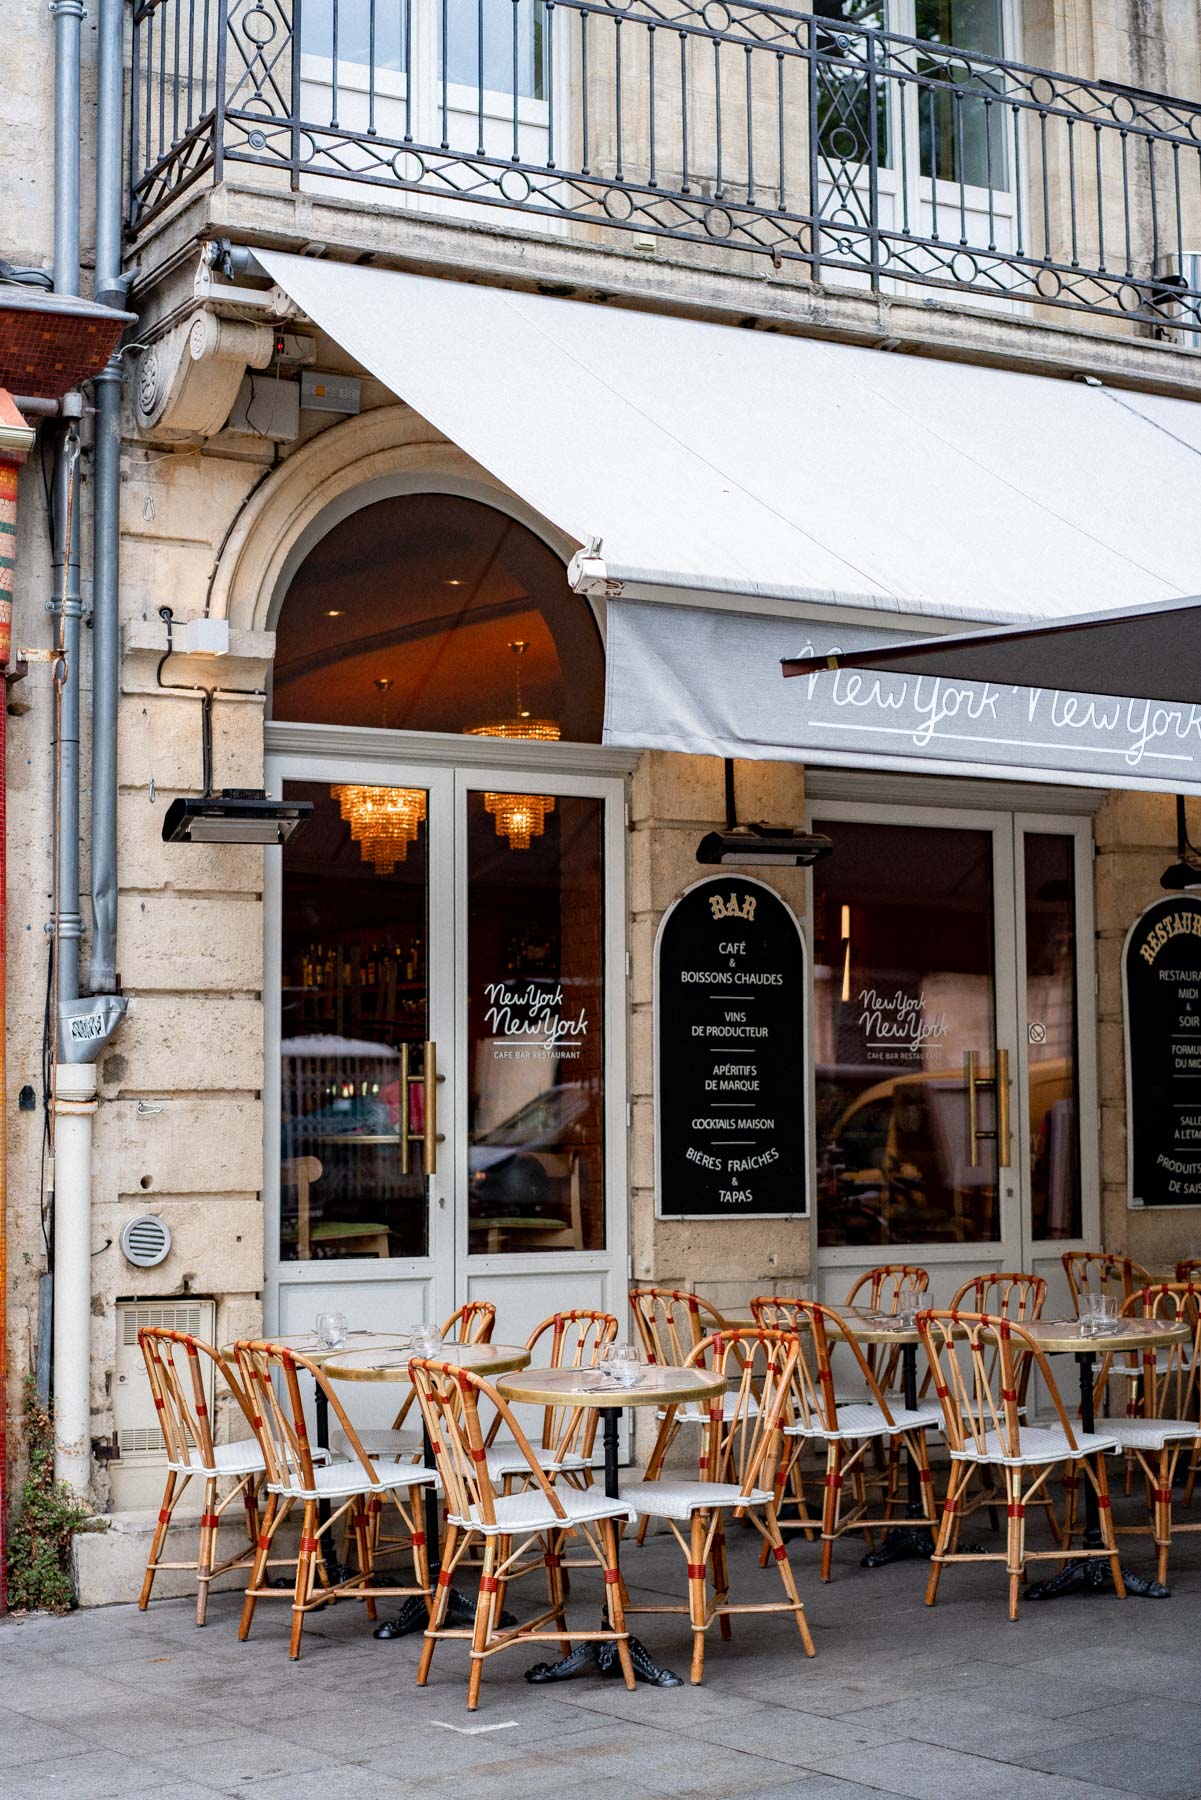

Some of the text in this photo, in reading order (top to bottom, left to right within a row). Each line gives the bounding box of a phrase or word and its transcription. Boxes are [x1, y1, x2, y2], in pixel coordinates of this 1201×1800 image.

[709, 893, 756, 921] BAR
[718, 940, 747, 955] CAFÉ
[728, 958, 736, 968] &
[681, 971, 783, 986] BOISSONS CHAUDES
[1178, 988, 1199, 1000] MIDI
[724, 1011, 747, 1023] VINS
[1178, 1015, 1201, 1028] SOIR
[691, 1025, 769, 1038] DE PRODUCTEUR
[494, 1051, 580, 1059] CAFE BAR RESTAURANT
[712, 1063, 758, 1076] APÉRITIFS
[1175, 1059, 1187, 1068] DU
[704, 1079, 760, 1092] DE MARQUE
[691, 1118, 775, 1130] COCKTAILS MAISON
[685, 1147, 722, 1171] BIÈRES
[731, 1176, 739, 1186] &
[1168, 1179, 1182, 1194] DE
[718, 1189, 753, 1203] TAPAS
